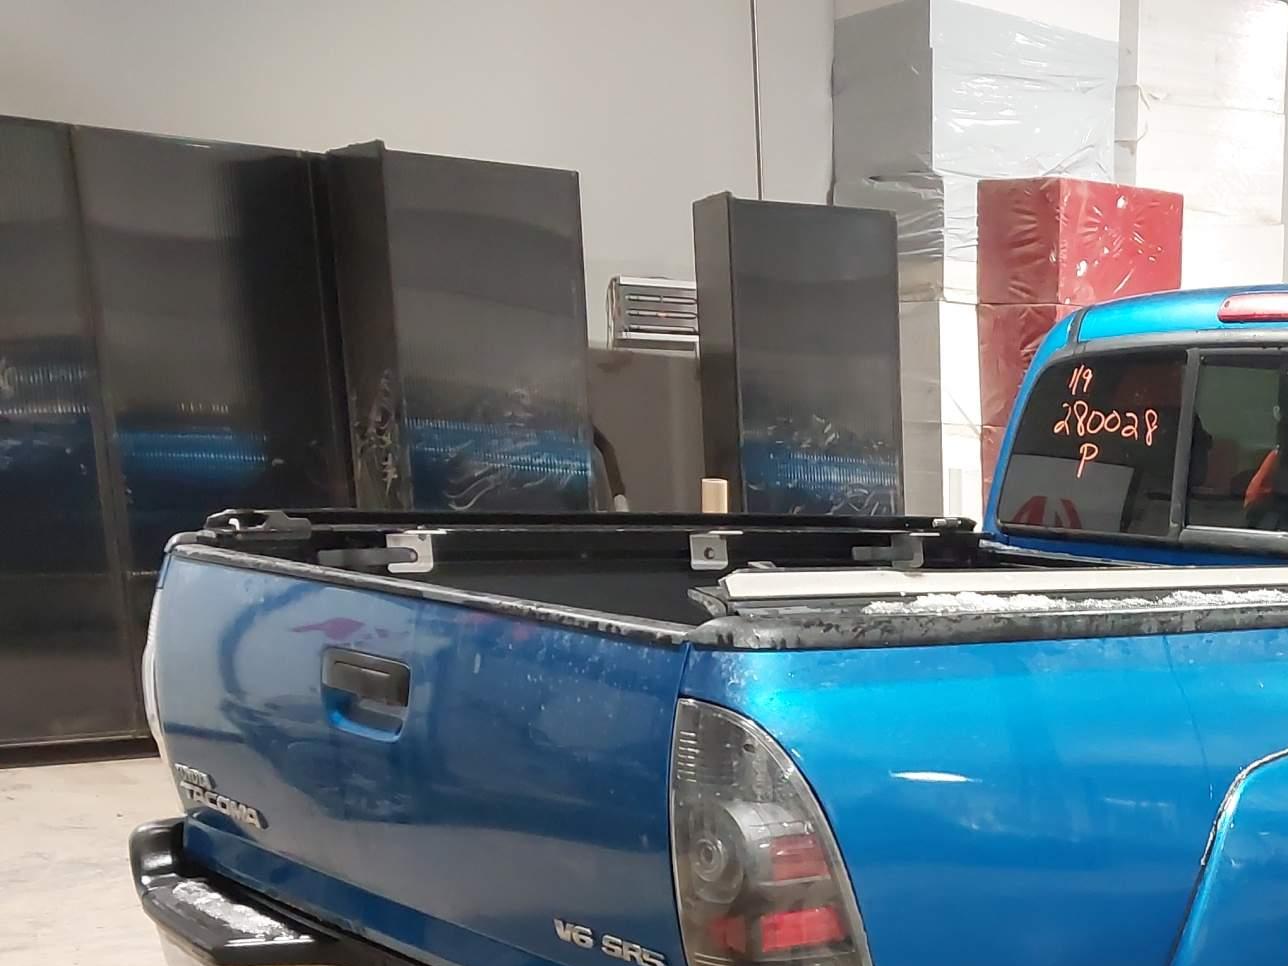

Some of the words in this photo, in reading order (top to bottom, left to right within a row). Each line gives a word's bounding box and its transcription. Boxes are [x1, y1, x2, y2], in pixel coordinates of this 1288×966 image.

[1053, 400, 1158, 446] 280028
[1076, 442, 1099, 478] P
[179, 780, 264, 829] TACOMA
[553, 918, 594, 949] V6
